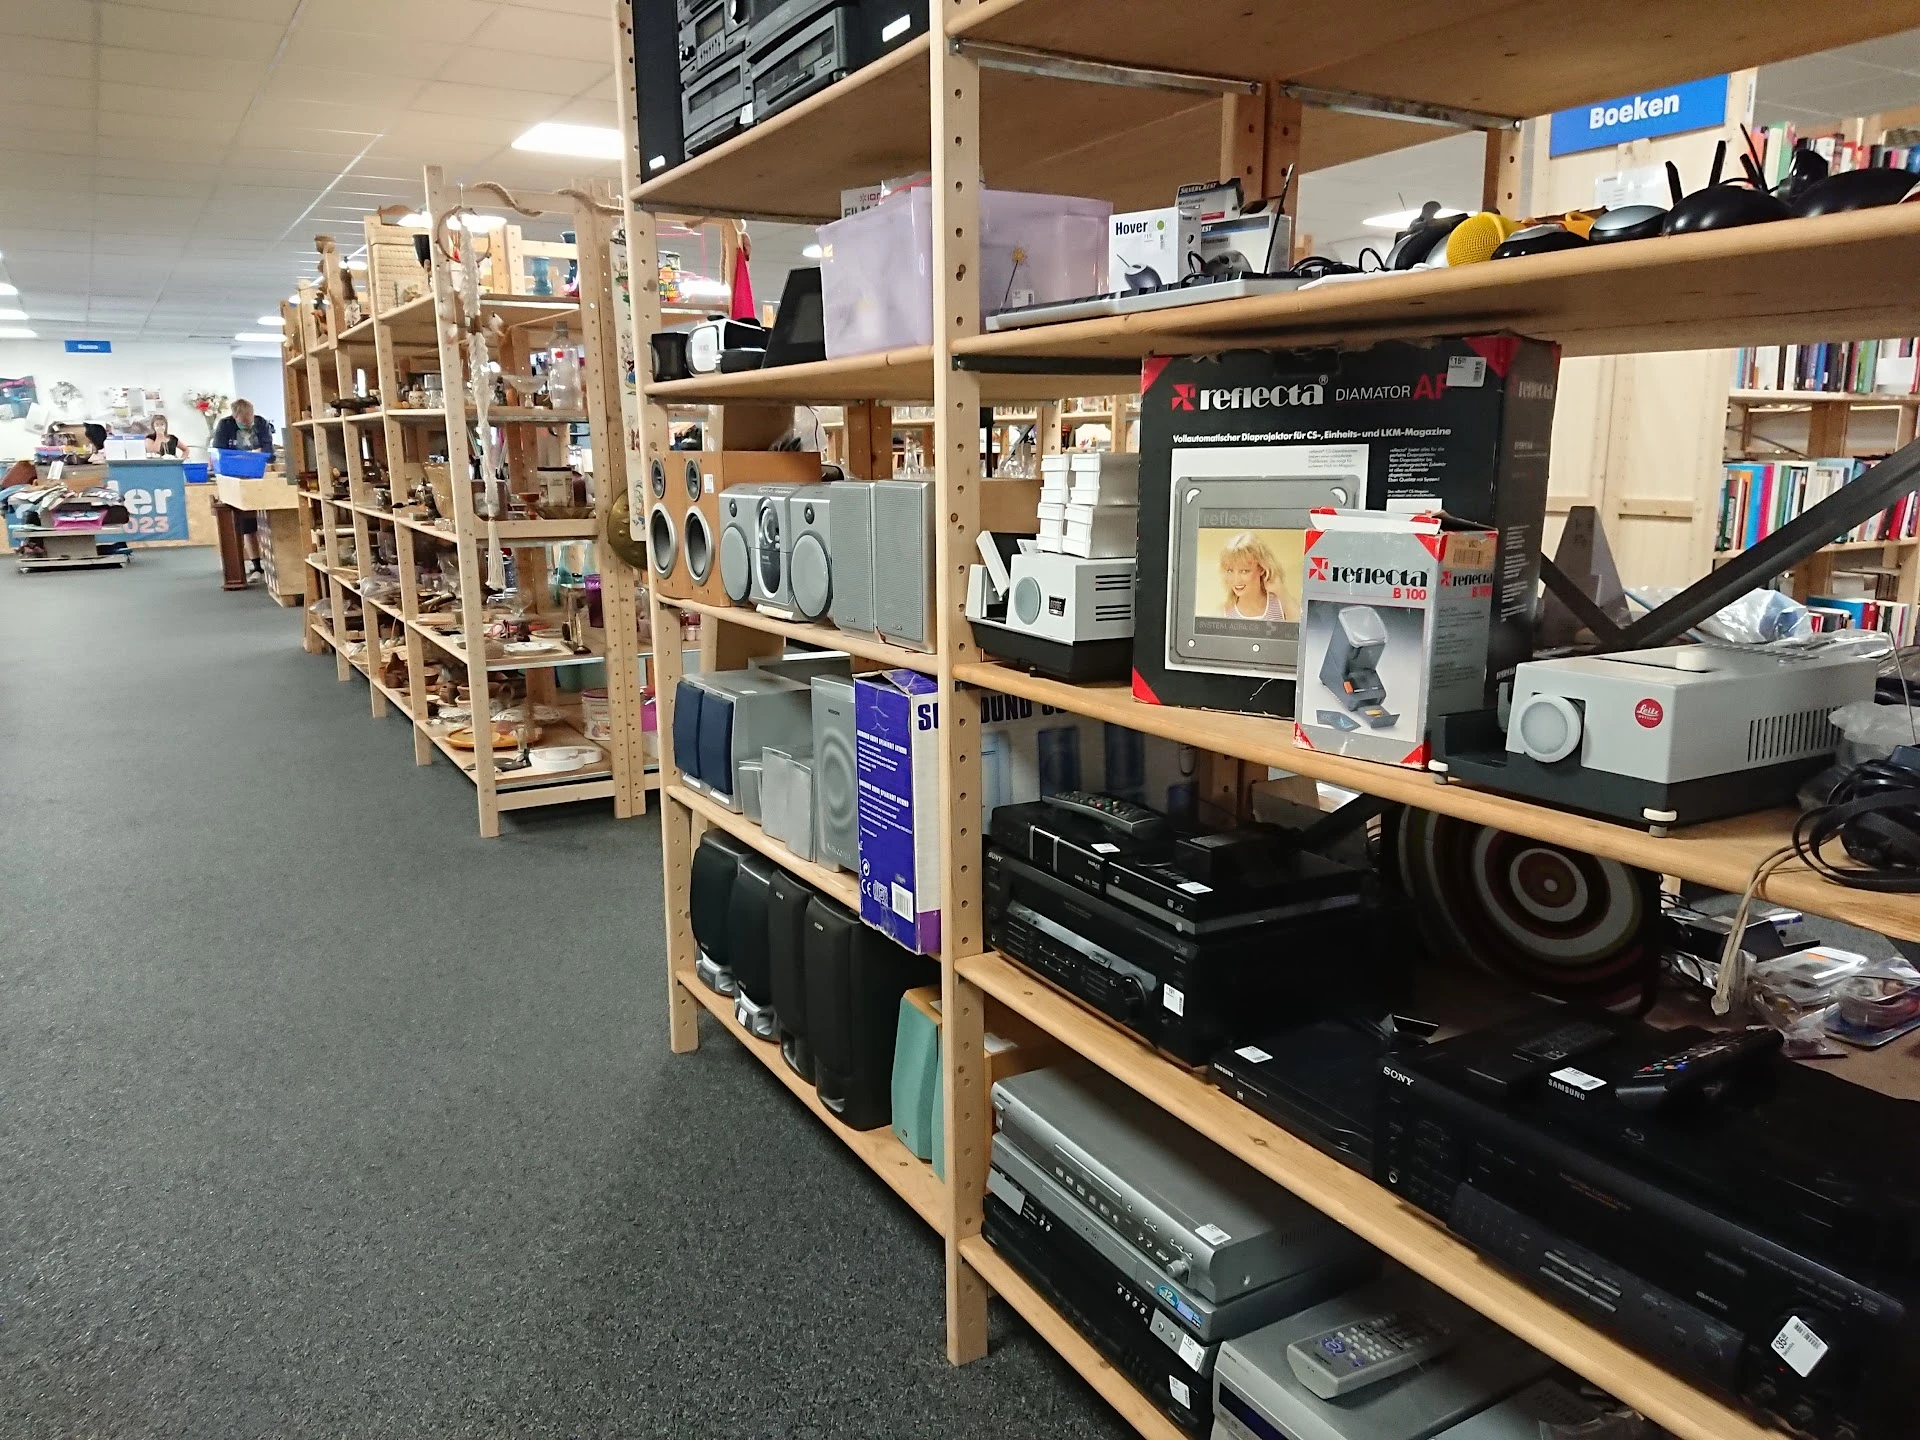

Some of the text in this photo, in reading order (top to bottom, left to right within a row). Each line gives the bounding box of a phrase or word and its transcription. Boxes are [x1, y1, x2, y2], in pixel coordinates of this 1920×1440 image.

[1589, 93, 1680, 129] Boeken
[1115, 222, 1149, 236] Hover
[1335, 384, 1411, 402] DIAMATOR
[1172, 433, 1241, 444] Vollautomatischer
[1241, 431, 1293, 443] Diaprojektor
[1293, 431, 1307, 440] für
[1323, 430, 1362, 440] Einheits-
[1361, 429, 1380, 439] und
[1380, 426, 1452, 437] LKM-Magazine
[123, 516, 170, 534] 023
[1332, 566, 1428, 588] reflecta
[1392, 587, 1427, 601] B 100
[987, 851, 1003, 863] SONY
[1383, 1066, 1415, 1087] SONY
[1547, 1078, 1586, 1101] SAMSUNG
